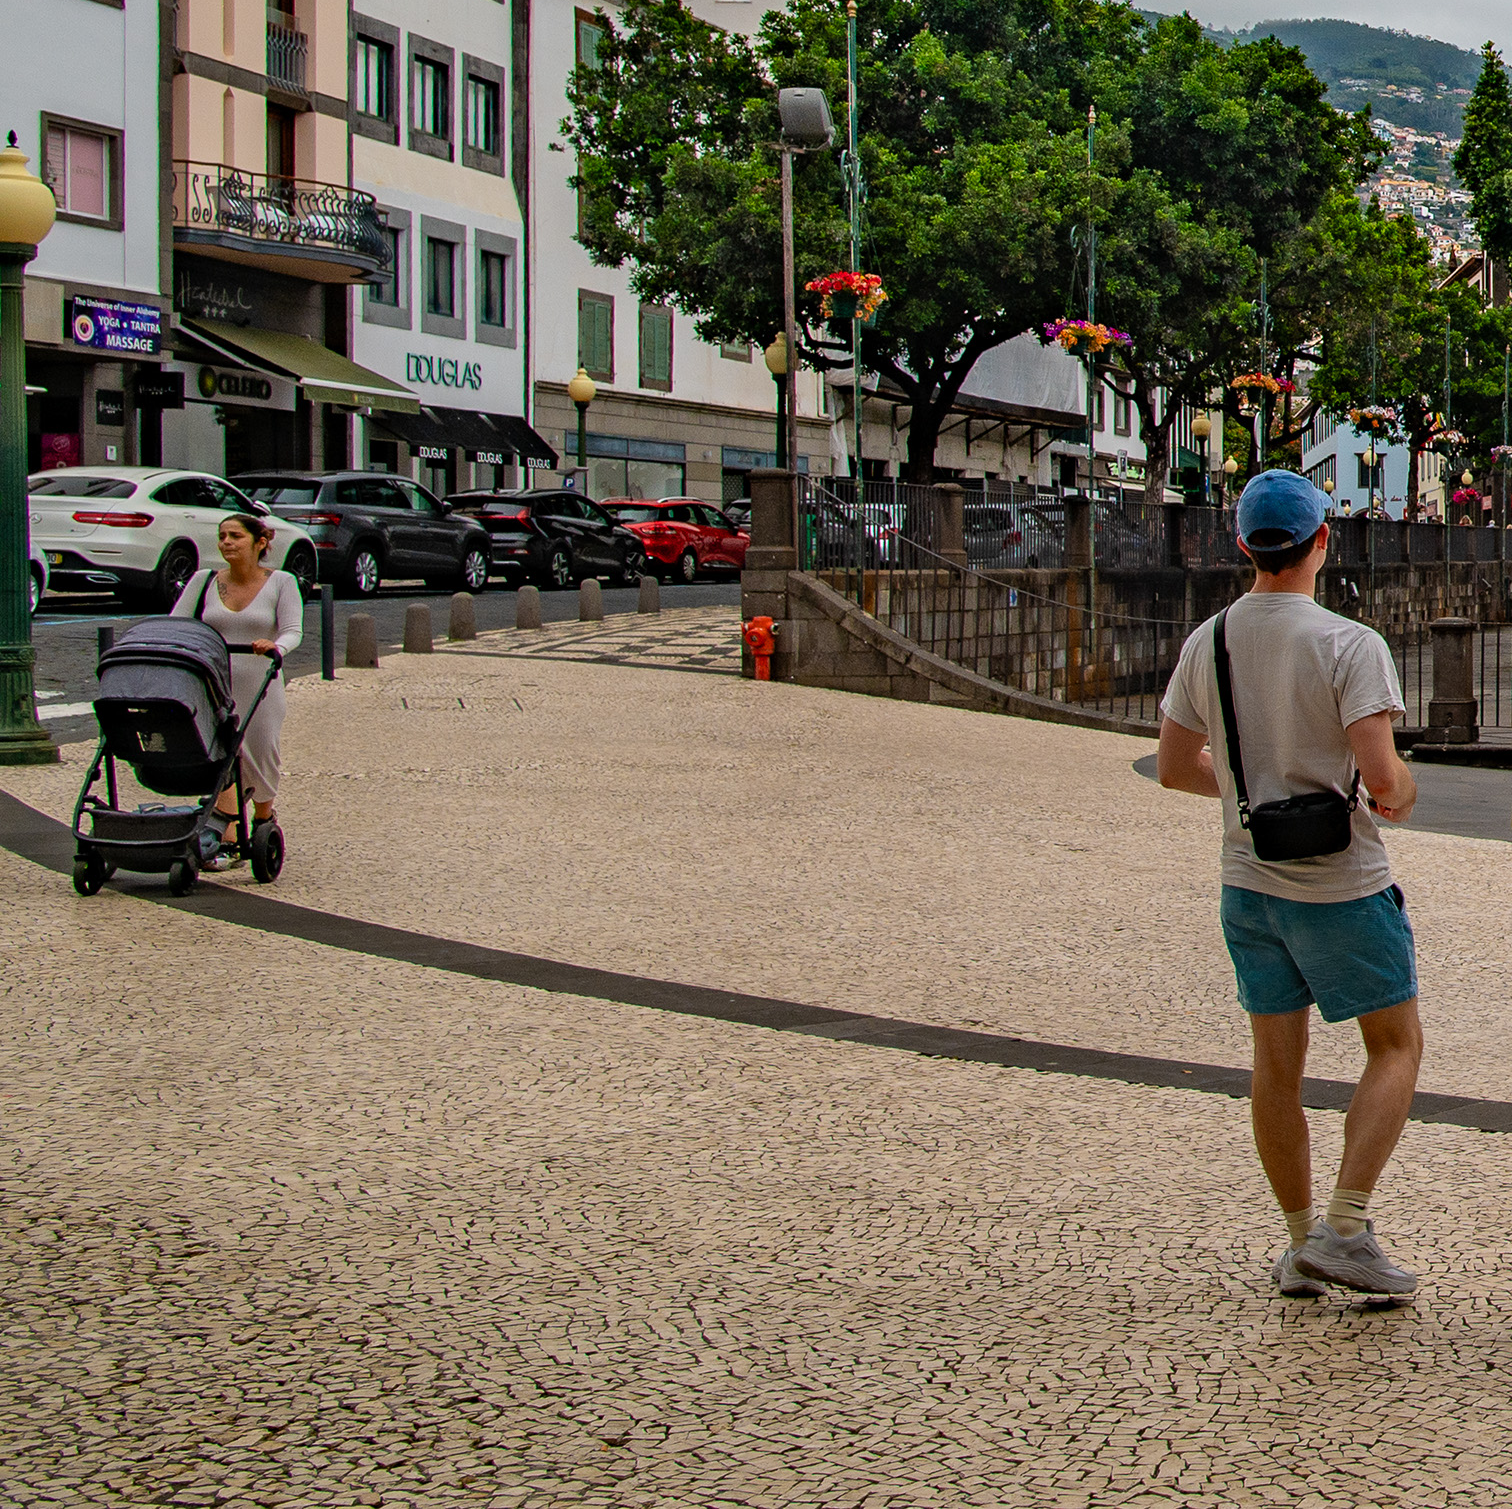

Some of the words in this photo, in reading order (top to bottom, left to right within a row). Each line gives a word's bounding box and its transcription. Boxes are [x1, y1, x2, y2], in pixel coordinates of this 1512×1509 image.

[74, 296, 86, 307] The
[86, 298, 113, 311] Universe
[113, 303, 120, 311] of
[120, 304, 136, 313] Inner
[98, 315, 120, 328] YOGA
[130, 320, 161, 334] TANTRA
[106, 334, 153, 352] MASSAGE
[406, 352, 482, 391] DOUGLAS
[419, 445, 447, 460] DOUGLAS
[477, 451, 503, 465] DOUGLAS
[528, 456, 551, 470] DOUGLAS
